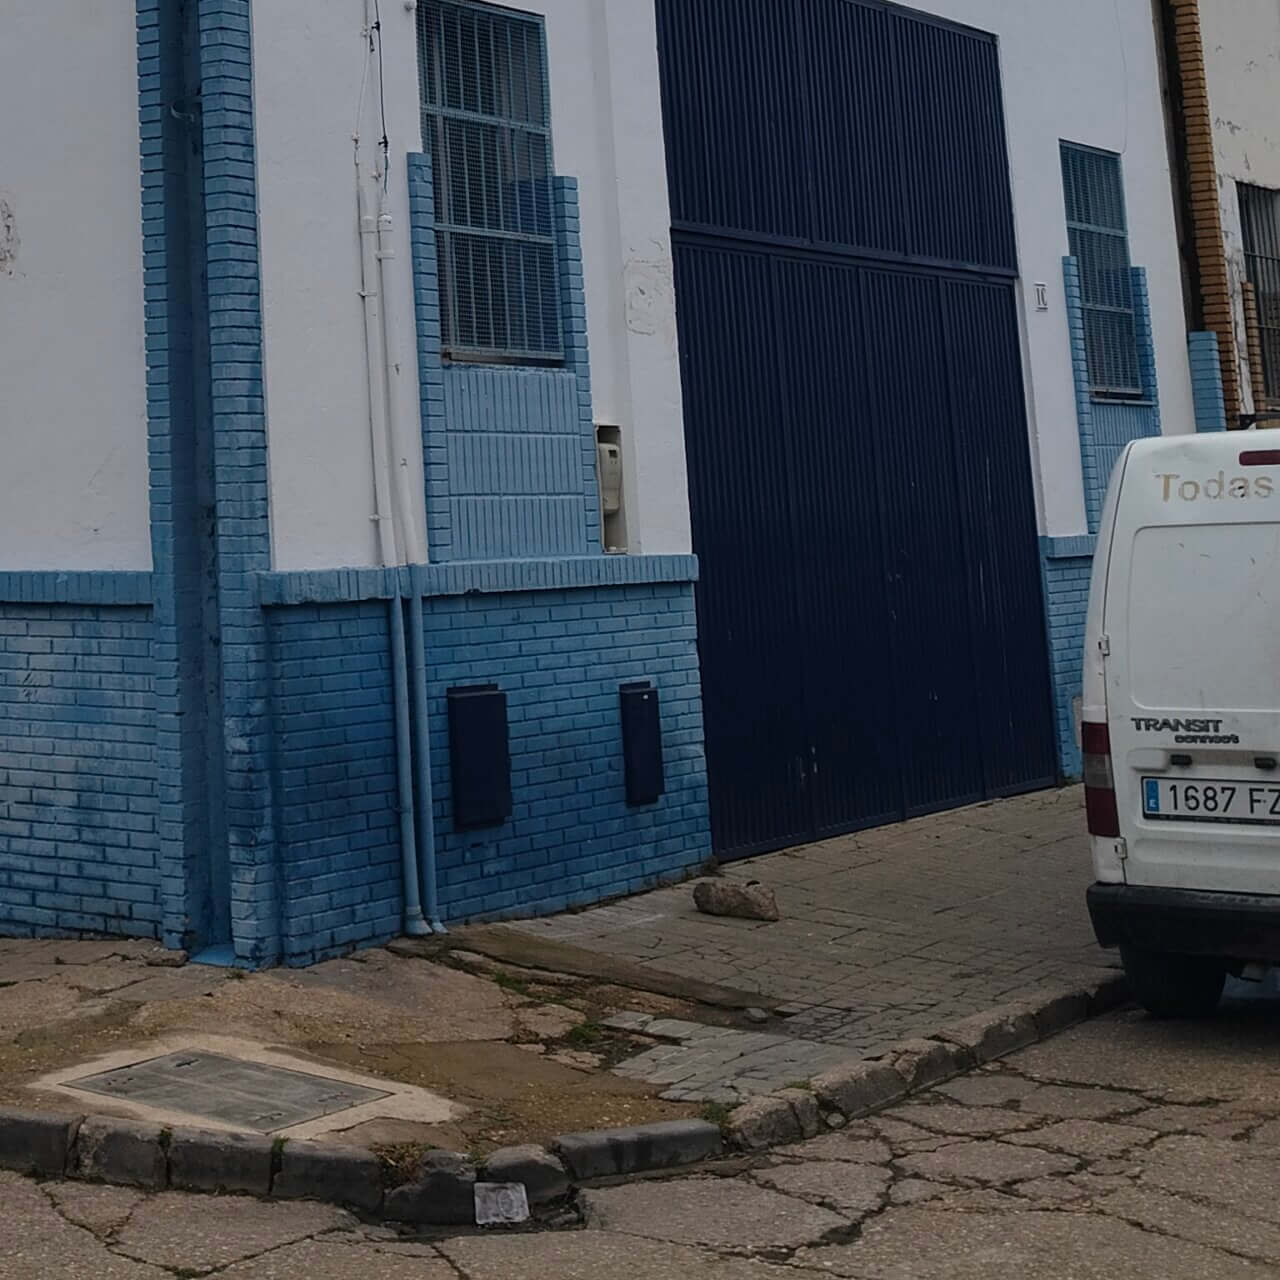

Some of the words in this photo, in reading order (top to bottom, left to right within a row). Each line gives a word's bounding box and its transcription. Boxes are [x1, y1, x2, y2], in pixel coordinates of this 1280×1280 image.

[1154, 470, 1273, 502] Todas
[1130, 717, 1223, 733] TRANSIT
[1169, 784, 1236, 813] 1687
